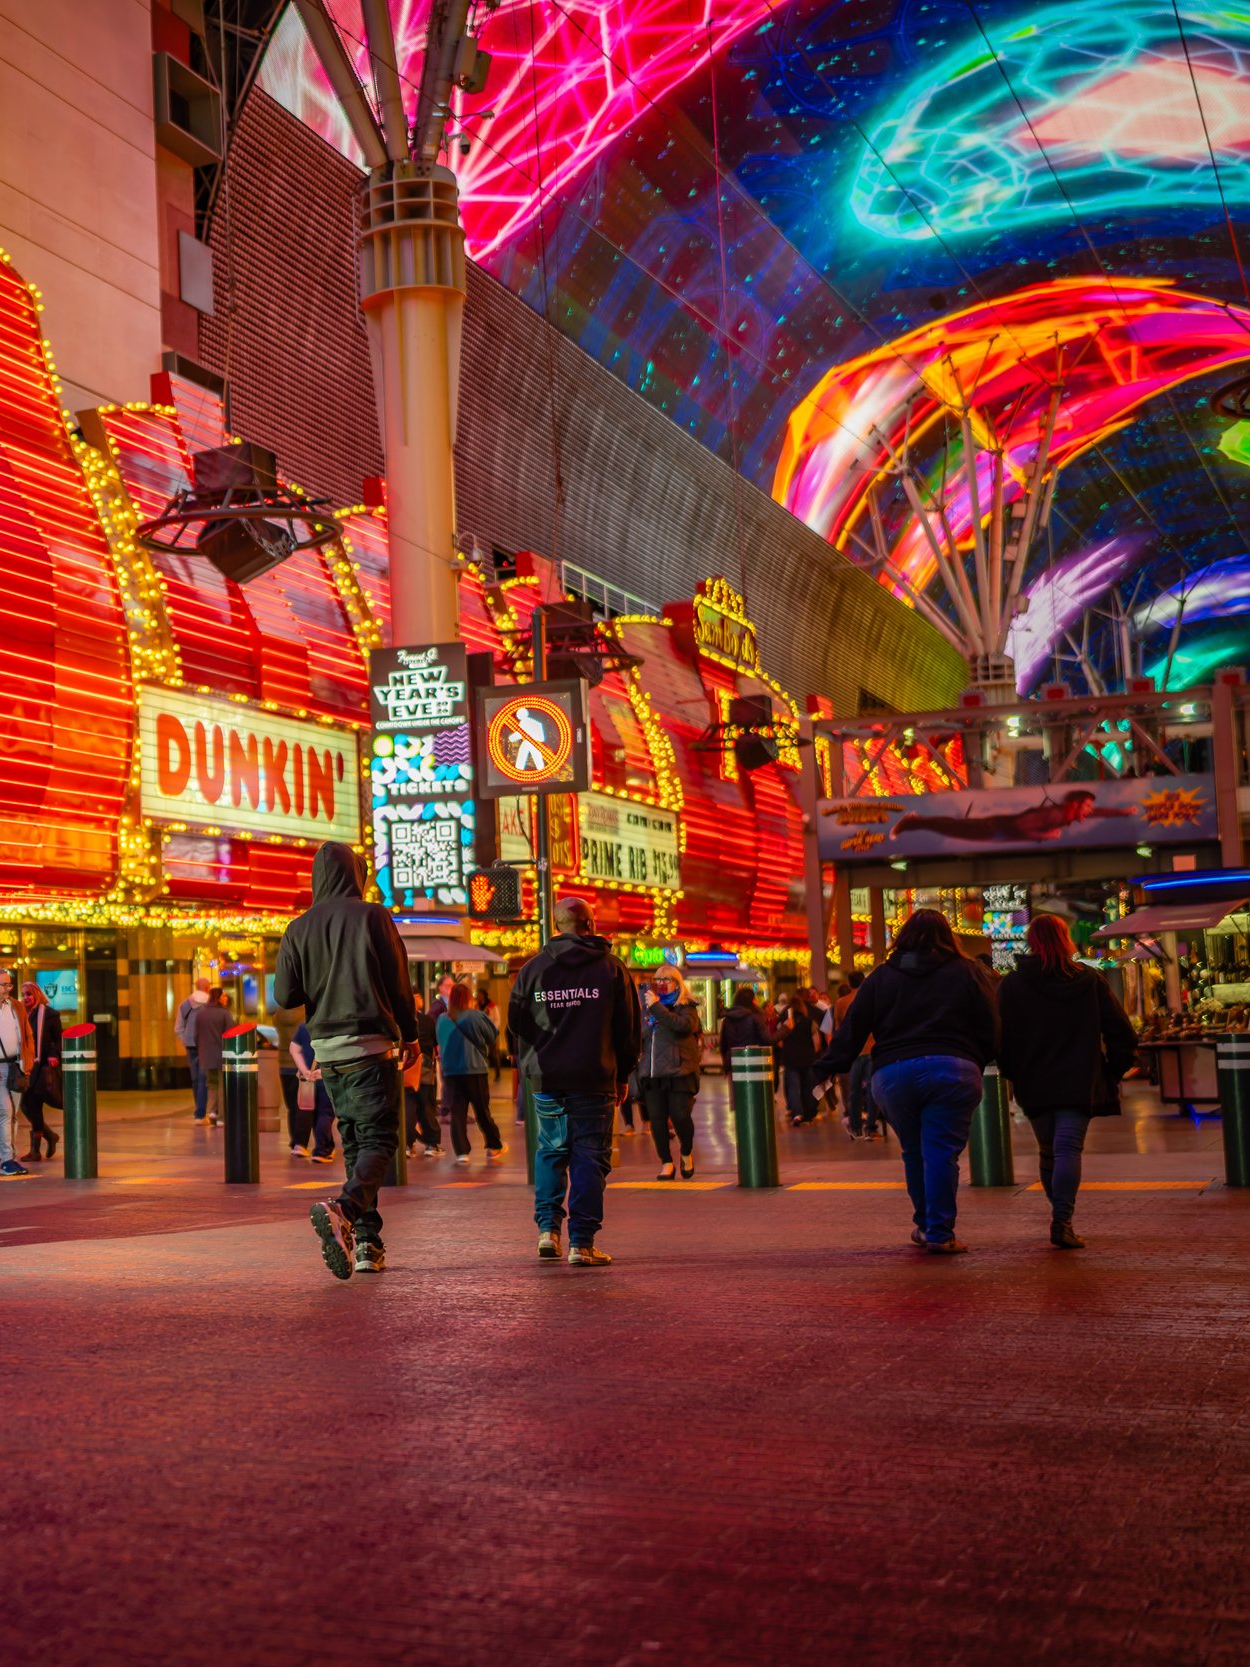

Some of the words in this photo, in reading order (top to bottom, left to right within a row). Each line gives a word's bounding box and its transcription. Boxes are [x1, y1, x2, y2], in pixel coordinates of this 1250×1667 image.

[391, 669, 443, 686] NEW
[380, 686, 460, 701] YEAR'S
[391, 702, 433, 718] EVE
[156, 713, 345, 822] DUNKIN'
[388, 780, 469, 795] TICKETS
[582, 837, 622, 878] PRIME
[629, 845, 647, 881] RIB
[534, 988, 599, 1002] ESSENTIALS
